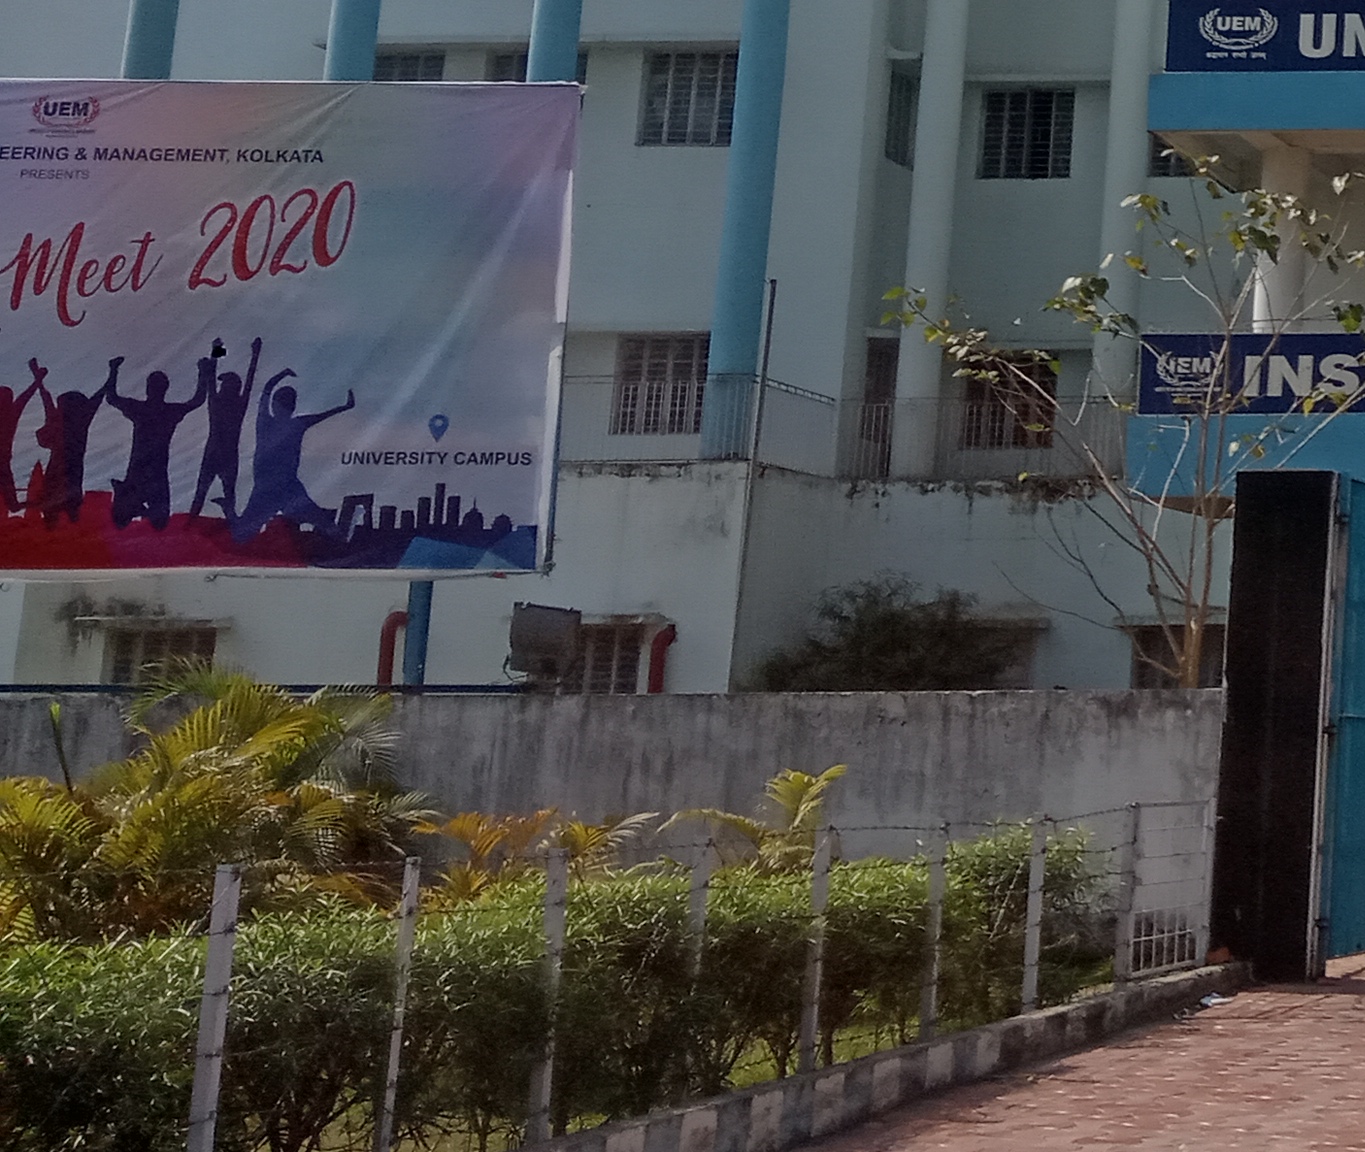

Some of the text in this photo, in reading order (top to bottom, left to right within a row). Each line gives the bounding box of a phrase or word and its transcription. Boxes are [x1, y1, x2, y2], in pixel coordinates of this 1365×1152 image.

[1216, 16, 1262, 31] UEM
[43, 101, 91, 117] UEM
[74, 147, 88, 161] &
[93, 147, 232, 165] MANAGEMENT,
[236, 149, 325, 164] KOLKATA
[20, 168, 90, 180] PRESENTS
[0, 179, 357, 328] Meet 2020
[340, 450, 533, 467] UNIVERSITY CAMPUS
